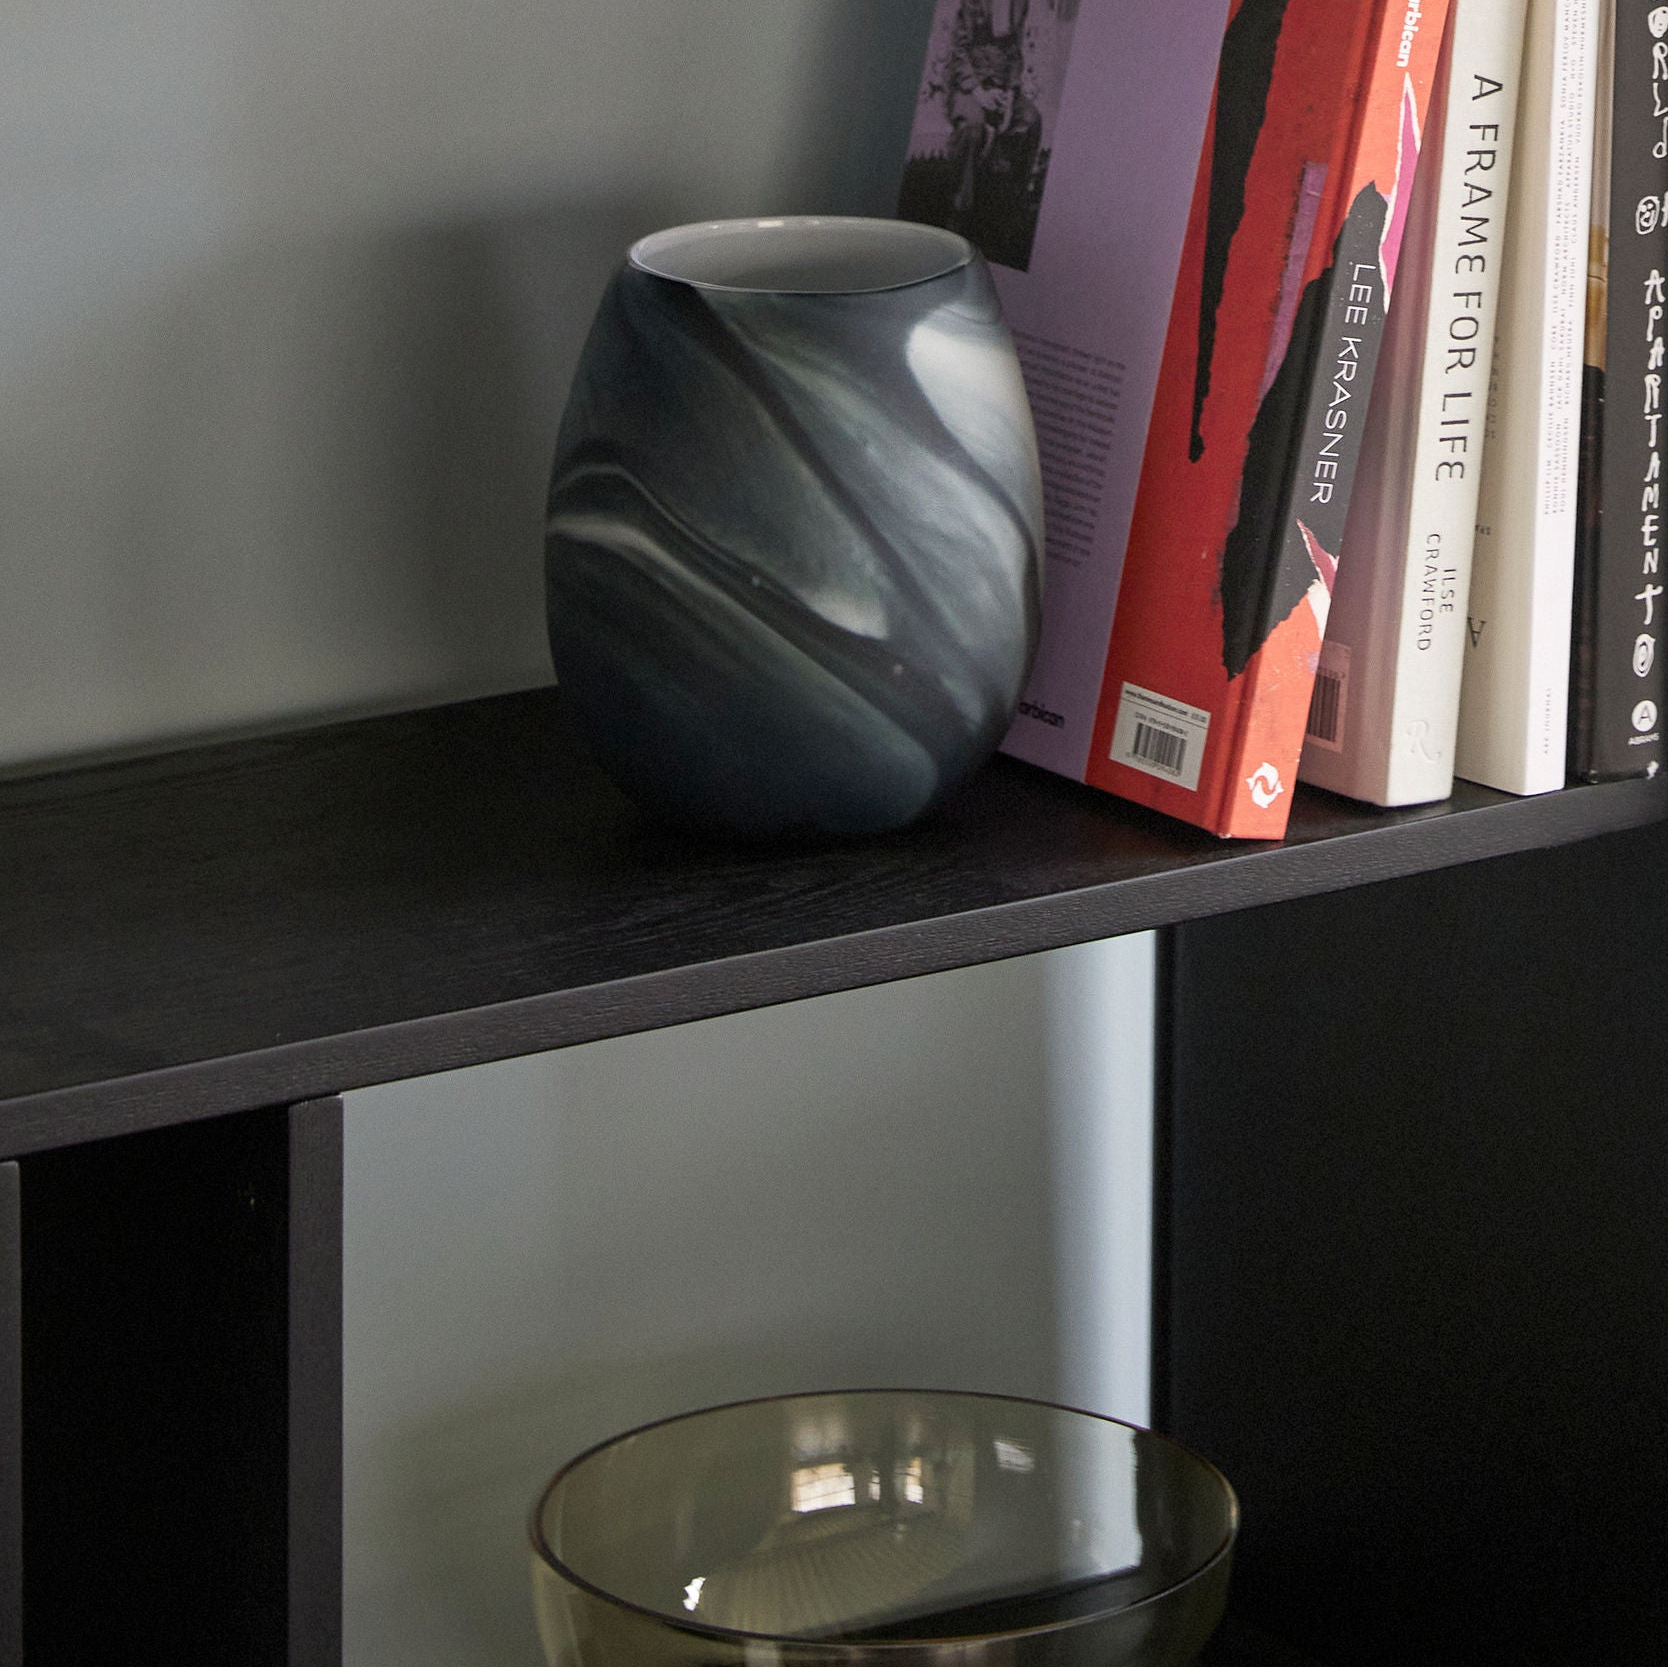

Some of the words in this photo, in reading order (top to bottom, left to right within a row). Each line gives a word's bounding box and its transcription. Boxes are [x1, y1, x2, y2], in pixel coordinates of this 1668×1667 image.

[1472, 74, 1503, 101] A
[1455, 124, 1499, 274] FRAME
[1344, 264, 1376, 325] LEE
[1445, 291, 1482, 374] FOR
[1310, 336, 1362, 504] KRASNER
[1435, 392, 1472, 481] LIFE
[1632, 269, 1666, 677] APARTAMENTO
[1417, 533, 1441, 651] CRAWFORD
[1439, 568, 1456, 613] ILSE
[1018, 701, 1065, 728] arbican
[1544, 688, 1552, 731] JOURNAL
